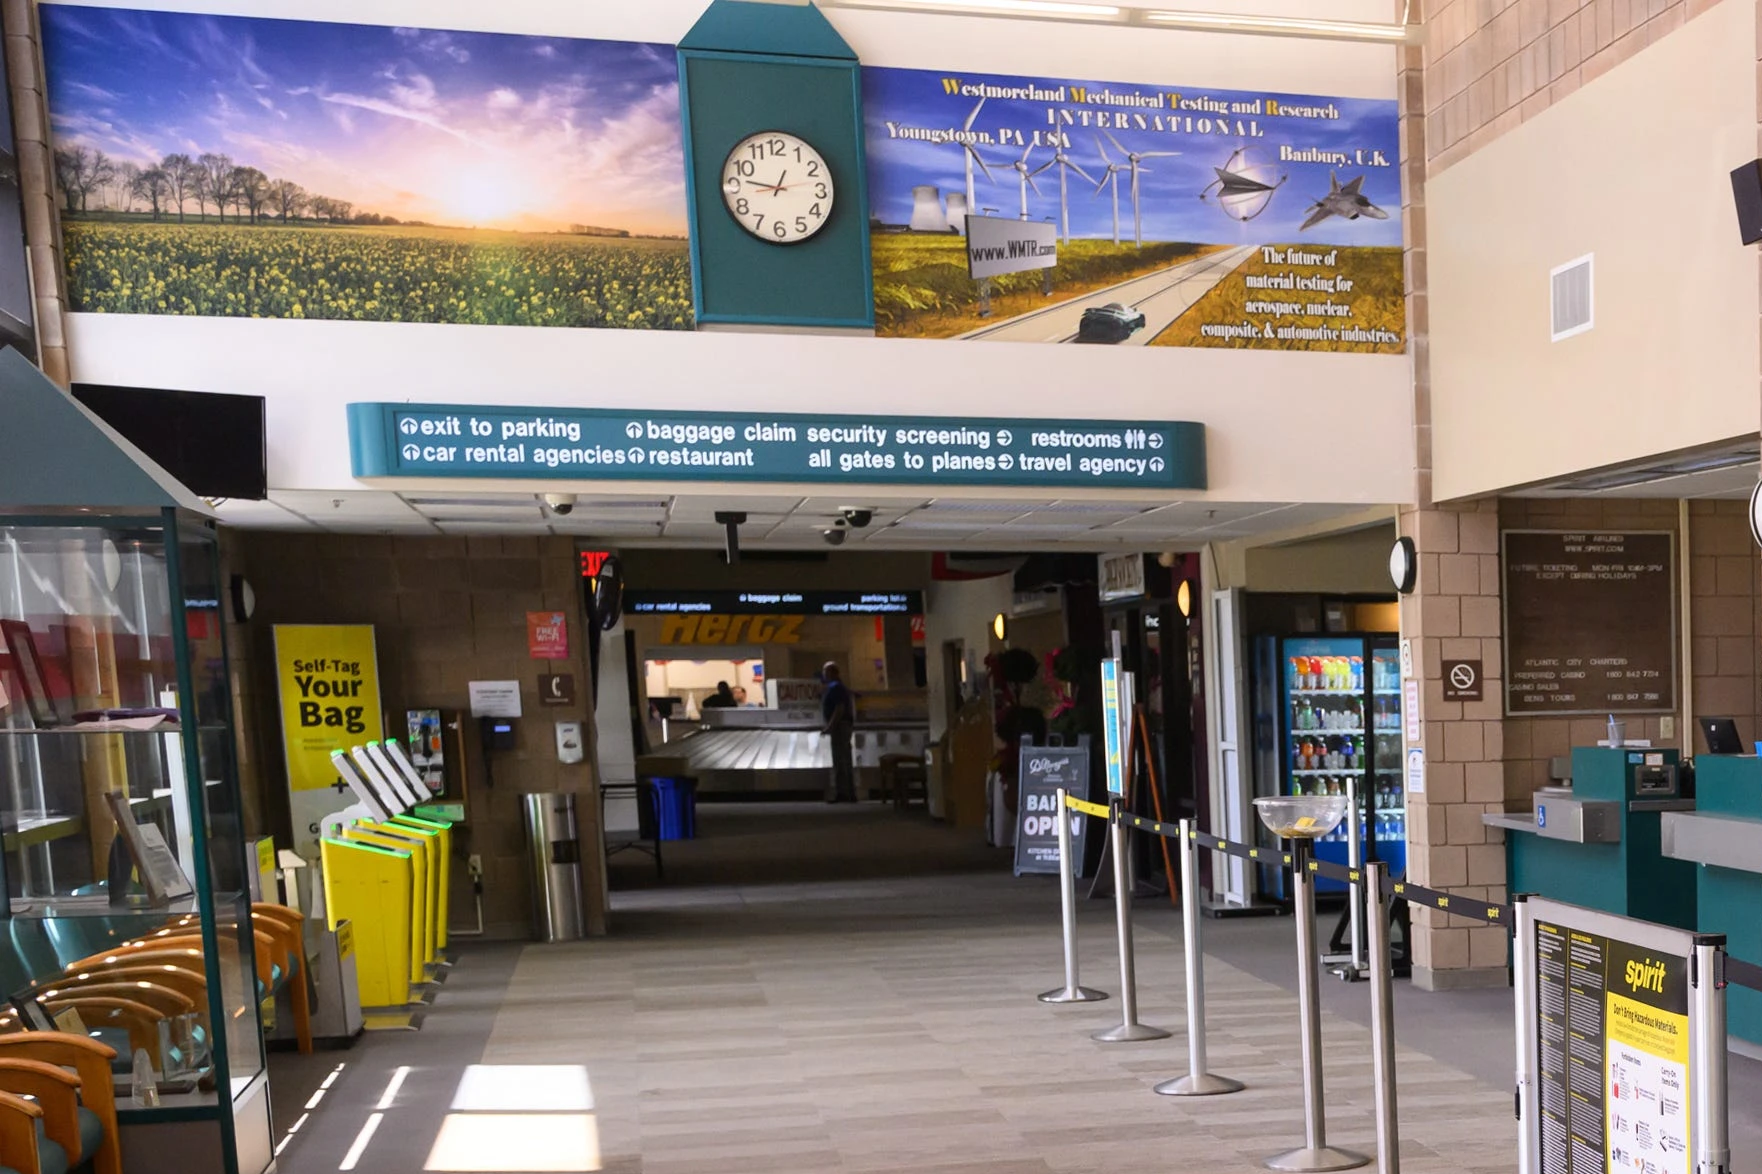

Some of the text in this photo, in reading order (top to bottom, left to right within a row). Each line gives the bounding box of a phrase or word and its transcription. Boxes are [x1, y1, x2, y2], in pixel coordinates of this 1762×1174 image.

[941, 78, 1339, 120] Westmoreland Mechanical Testing and Research
[1047, 108, 1264, 137] INTERNATIONAL
[885, 121, 1071, 148] Youngstown, PA USA
[747, 143, 764, 160] 11
[766, 139, 786, 156] 12
[793, 146, 801, 163] 1
[1279, 145, 1352, 168] Banbury,
[733, 160, 755, 177] 10
[806, 160, 819, 178] 2
[814, 182, 828, 200] 3
[736, 198, 750, 215] 8
[808, 202, 822, 219] 4
[753, 213, 765, 230] 7
[773, 220, 786, 238] 6
[795, 216, 808, 233] 5
[1261, 246, 1338, 266] The future of
[1245, 272, 1353, 293] material testing for
[1263, 322, 1276, 339] &
[1277, 324, 1339, 341] automotive
[1341, 325, 1400, 343] industries.
[421, 417, 796, 443] exit to parking baggage claim
[807, 425, 1122, 449] security screening restrooms
[423, 444, 755, 468] car rental agencies restaurant
[808, 449, 1147, 477] all gates to planes travel agency
[580, 551, 609, 577] EXIT
[659, 614, 806, 645] Hertz
[293, 659, 360, 676] Self-Tag
[294, 675, 363, 698] Your
[299, 701, 366, 734] Bag
[1625, 958, 1666, 993] spirit
